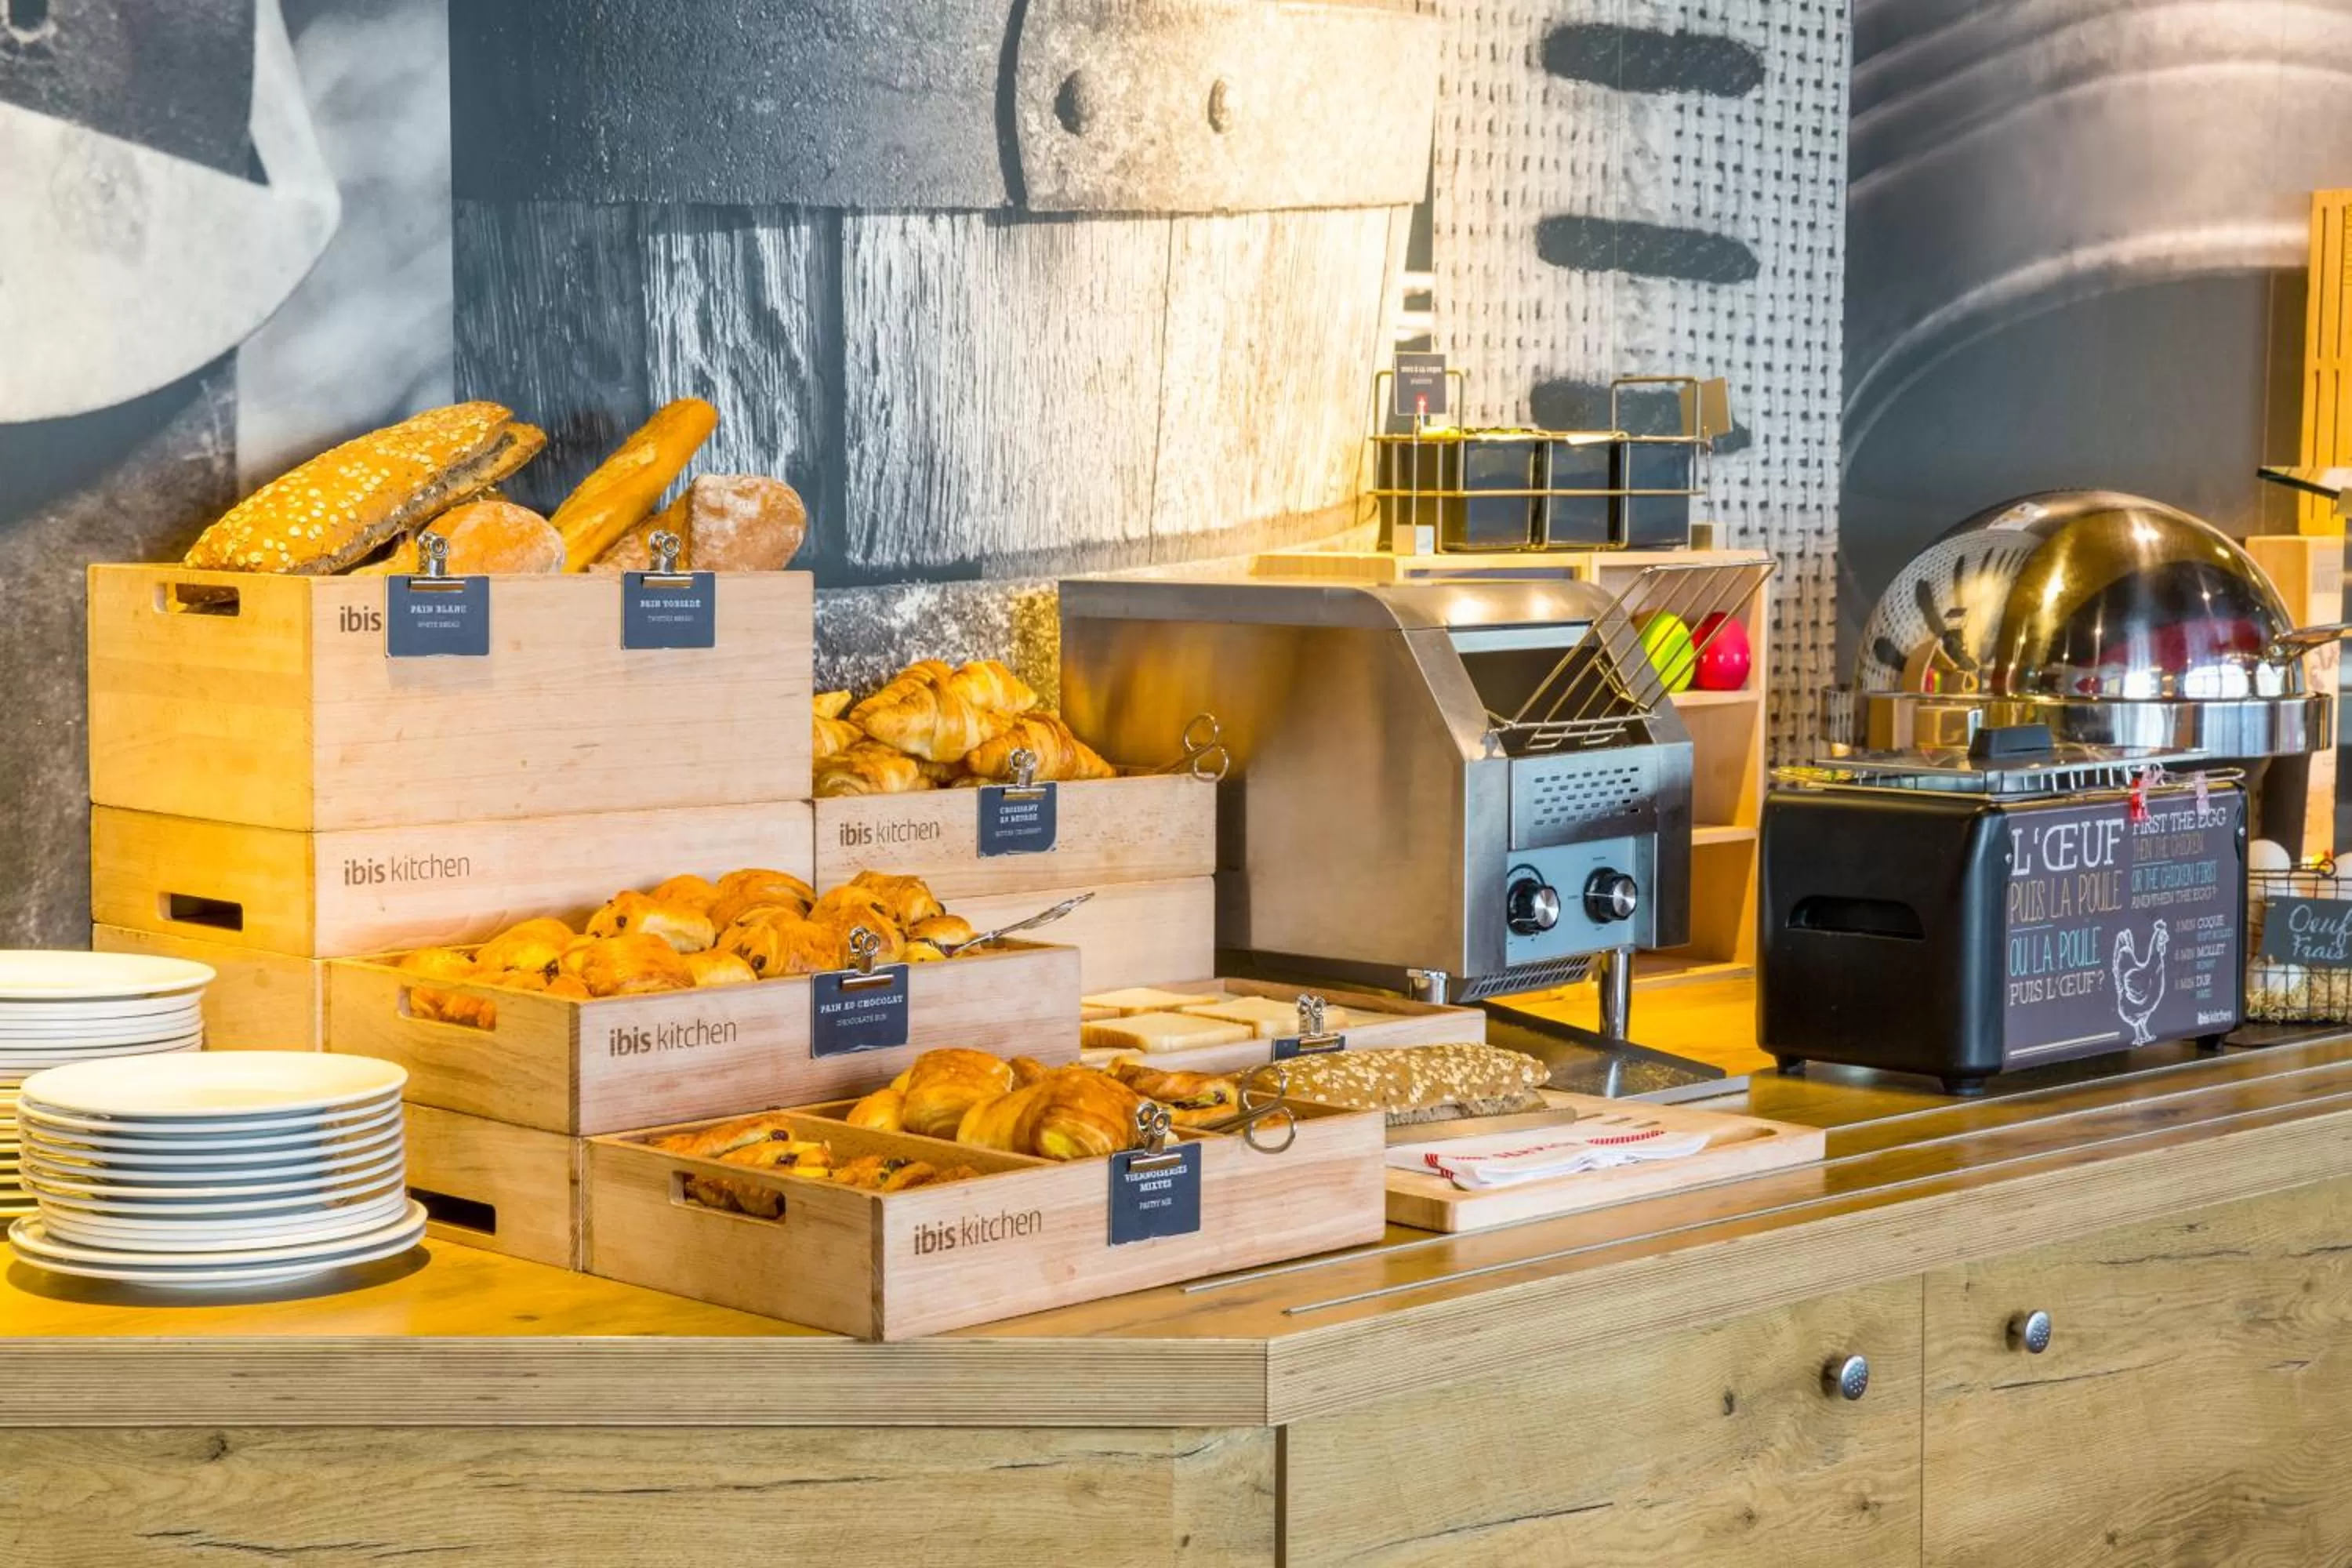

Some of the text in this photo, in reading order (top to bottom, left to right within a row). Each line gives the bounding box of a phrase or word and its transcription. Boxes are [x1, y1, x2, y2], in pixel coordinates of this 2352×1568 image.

[339, 605, 382, 633] ibis
[840, 818, 940, 847] ibis kitchen
[2169, 810, 2196, 832] THE
[2198, 806, 2227, 829] EGG
[343, 853, 470, 886] ibis kitchen
[2009, 869, 2124, 925] PUIS LA POULE
[2009, 925, 2103, 978] OU LA POULE
[2292, 934, 2349, 960] Frais
[820, 1003, 841, 1014] PAIN
[857, 994, 904, 1008] CHOCOLAT
[2009, 978, 2044, 1007] PUIS
[609, 1018, 737, 1057] ibis kitchen
[1139, 1178, 1172, 1192] MIXTES
[914, 1208, 1042, 1255] ibis kitchen
